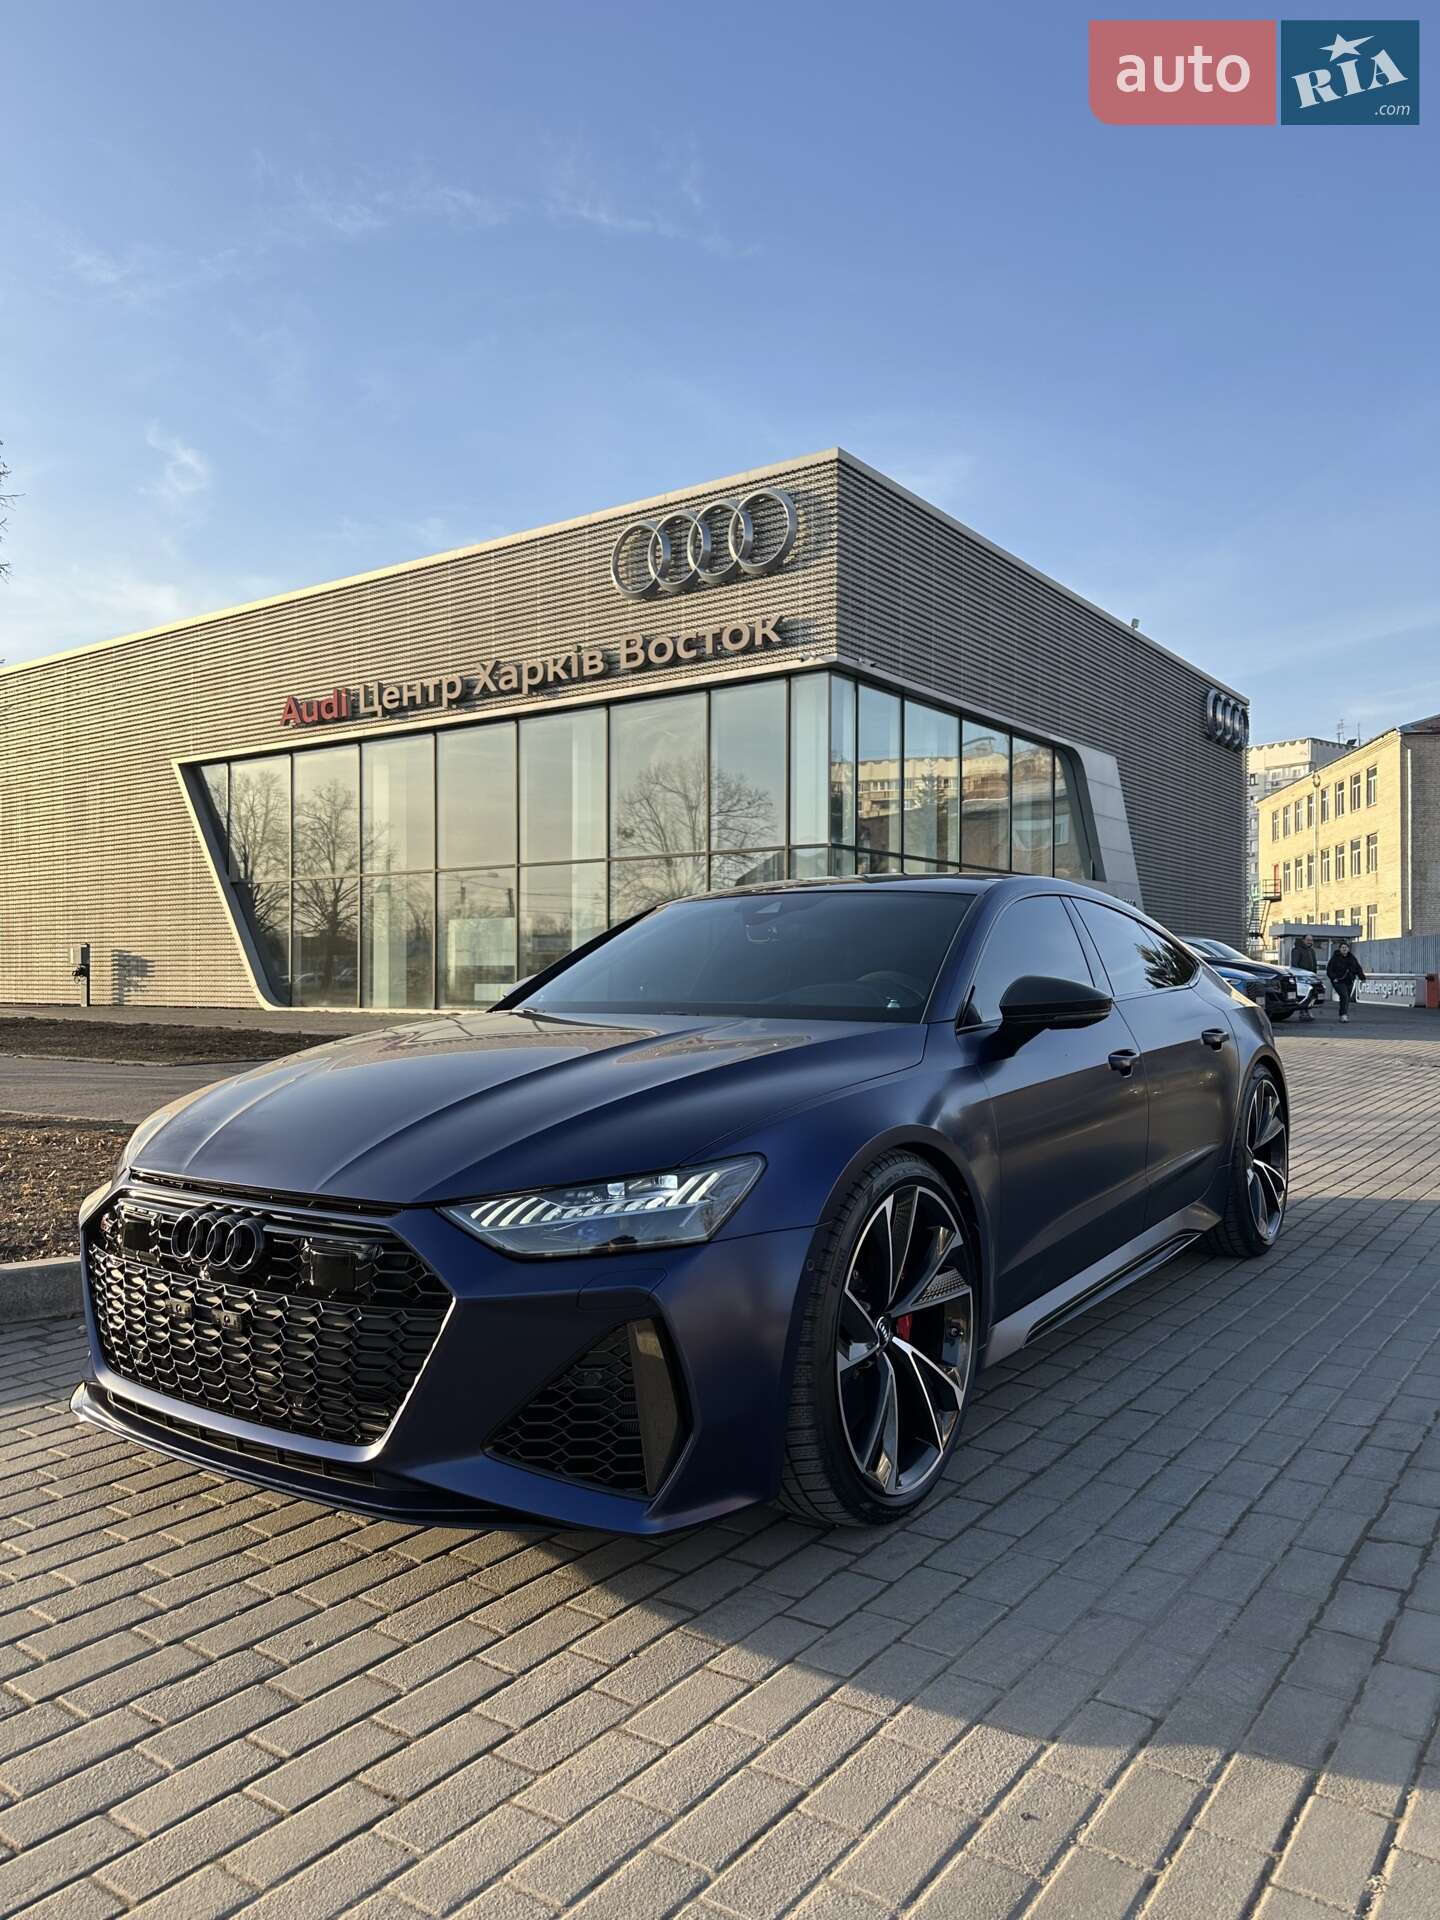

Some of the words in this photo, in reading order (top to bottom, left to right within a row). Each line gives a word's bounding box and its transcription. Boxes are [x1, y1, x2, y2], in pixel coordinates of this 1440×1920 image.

[280, 688, 349, 726] Audi
[359, 674, 462, 718] Центр
[472, 645, 605, 696] Харків
[619, 615, 783, 670] Восток
